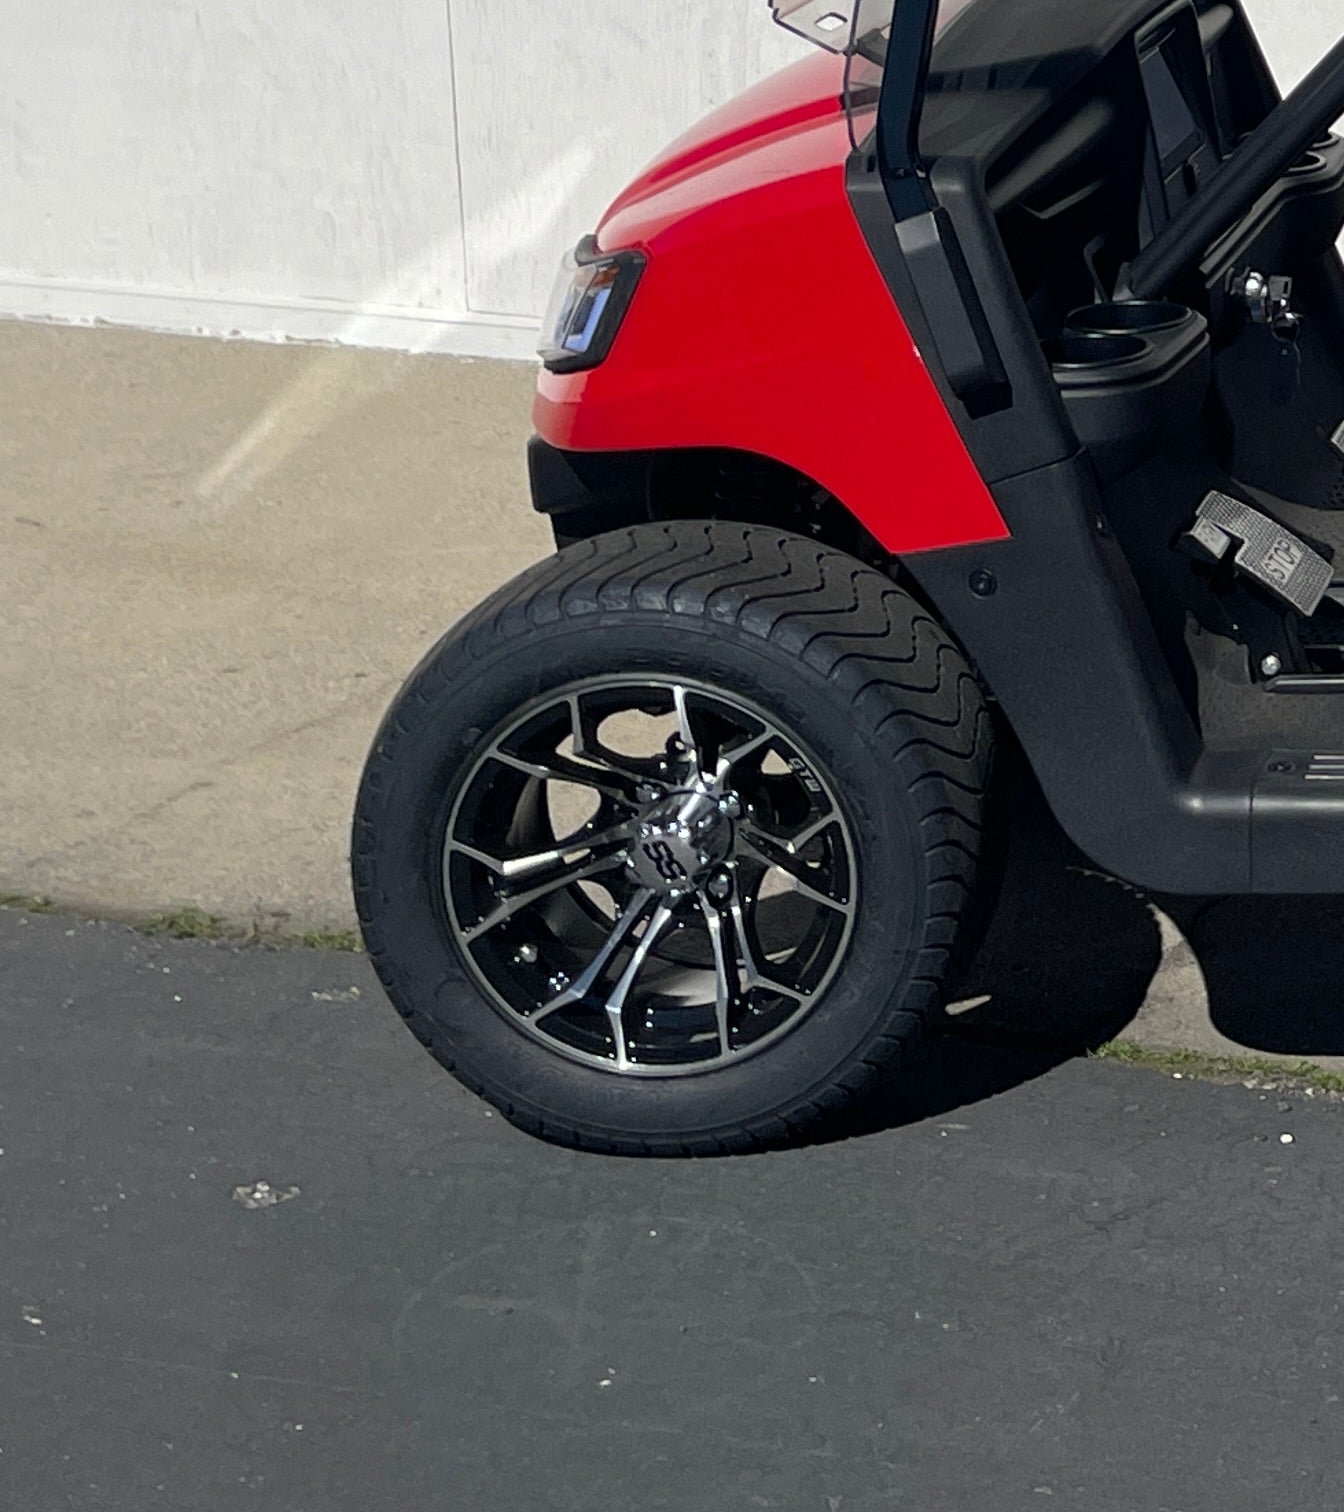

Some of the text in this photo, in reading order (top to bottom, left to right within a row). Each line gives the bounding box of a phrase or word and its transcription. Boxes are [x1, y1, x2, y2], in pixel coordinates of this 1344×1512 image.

[1264, 538, 1299, 581] STOP
[789, 757, 821, 792] GTW
[642, 840, 688, 880] SS
